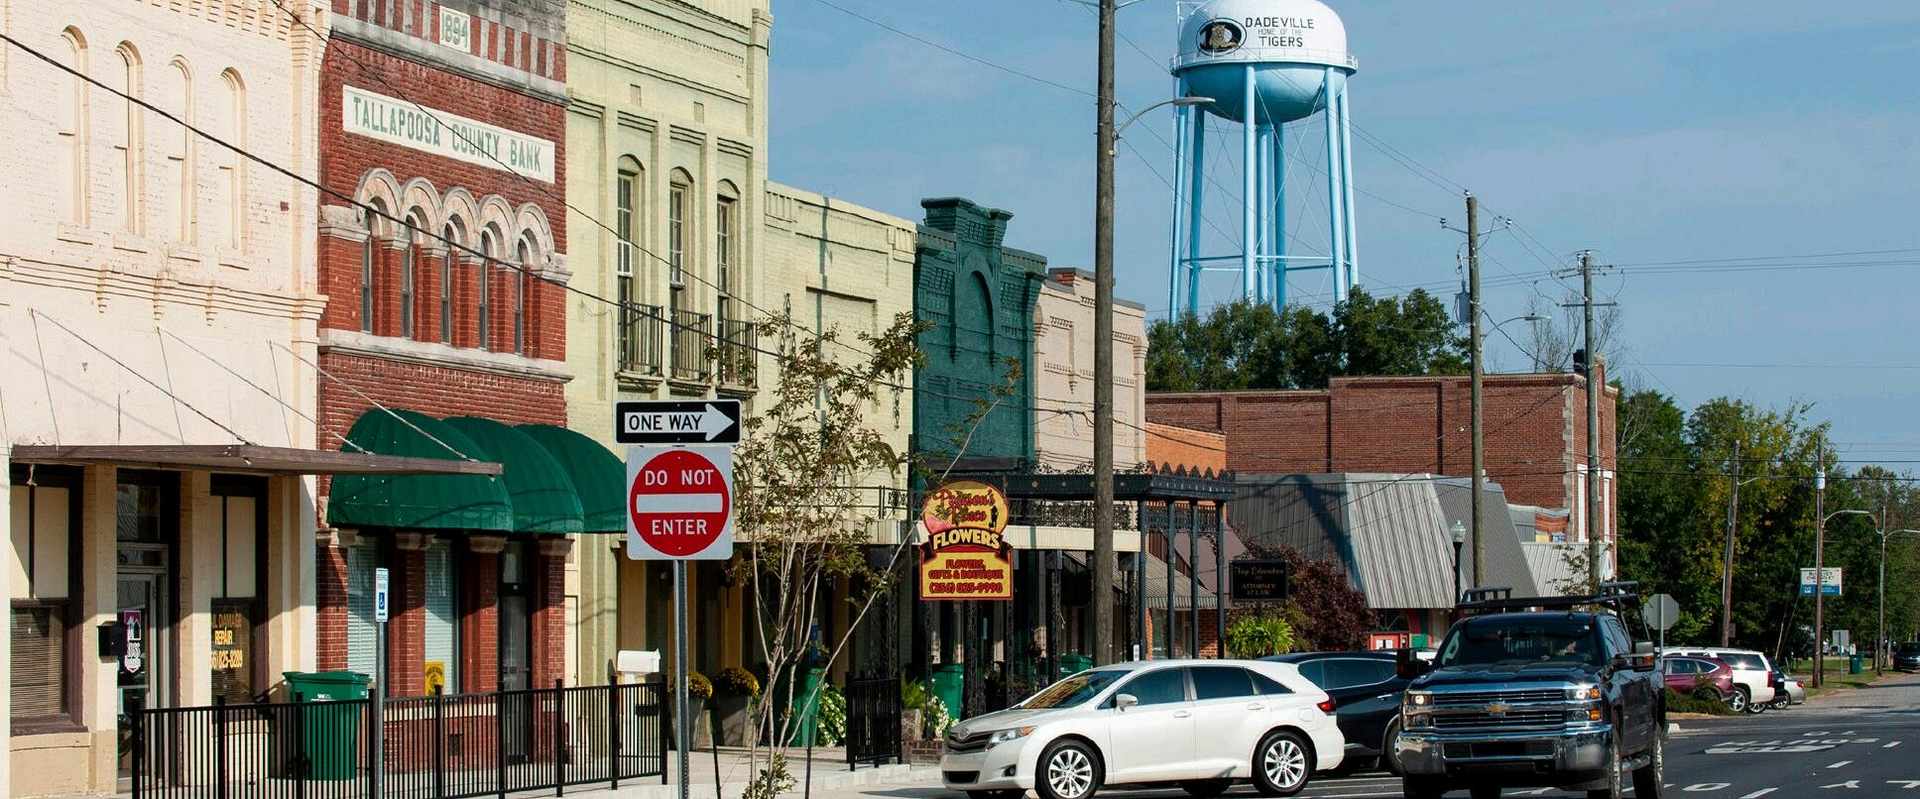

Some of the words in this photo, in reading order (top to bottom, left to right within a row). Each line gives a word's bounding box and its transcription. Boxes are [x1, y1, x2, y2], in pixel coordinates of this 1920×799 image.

[441, 14, 468, 46] 1894
[1245, 17, 1314, 29] DADEVILLE
[1259, 36, 1303, 47] TIGERS
[353, 97, 440, 148] TALLAPOOSA
[452, 123, 500, 161] COUNTY
[510, 138, 542, 173] BANK
[629, 415, 662, 430] ONE
[669, 415, 702, 430] WAY
[645, 470, 668, 486] DO
[681, 469, 714, 485] NOT
[652, 519, 707, 535] ENTER
[933, 528, 1000, 550] FLOWERS
[960, 570, 1003, 580] BOUTIQUE
[215, 630, 232, 645] REPAIR
